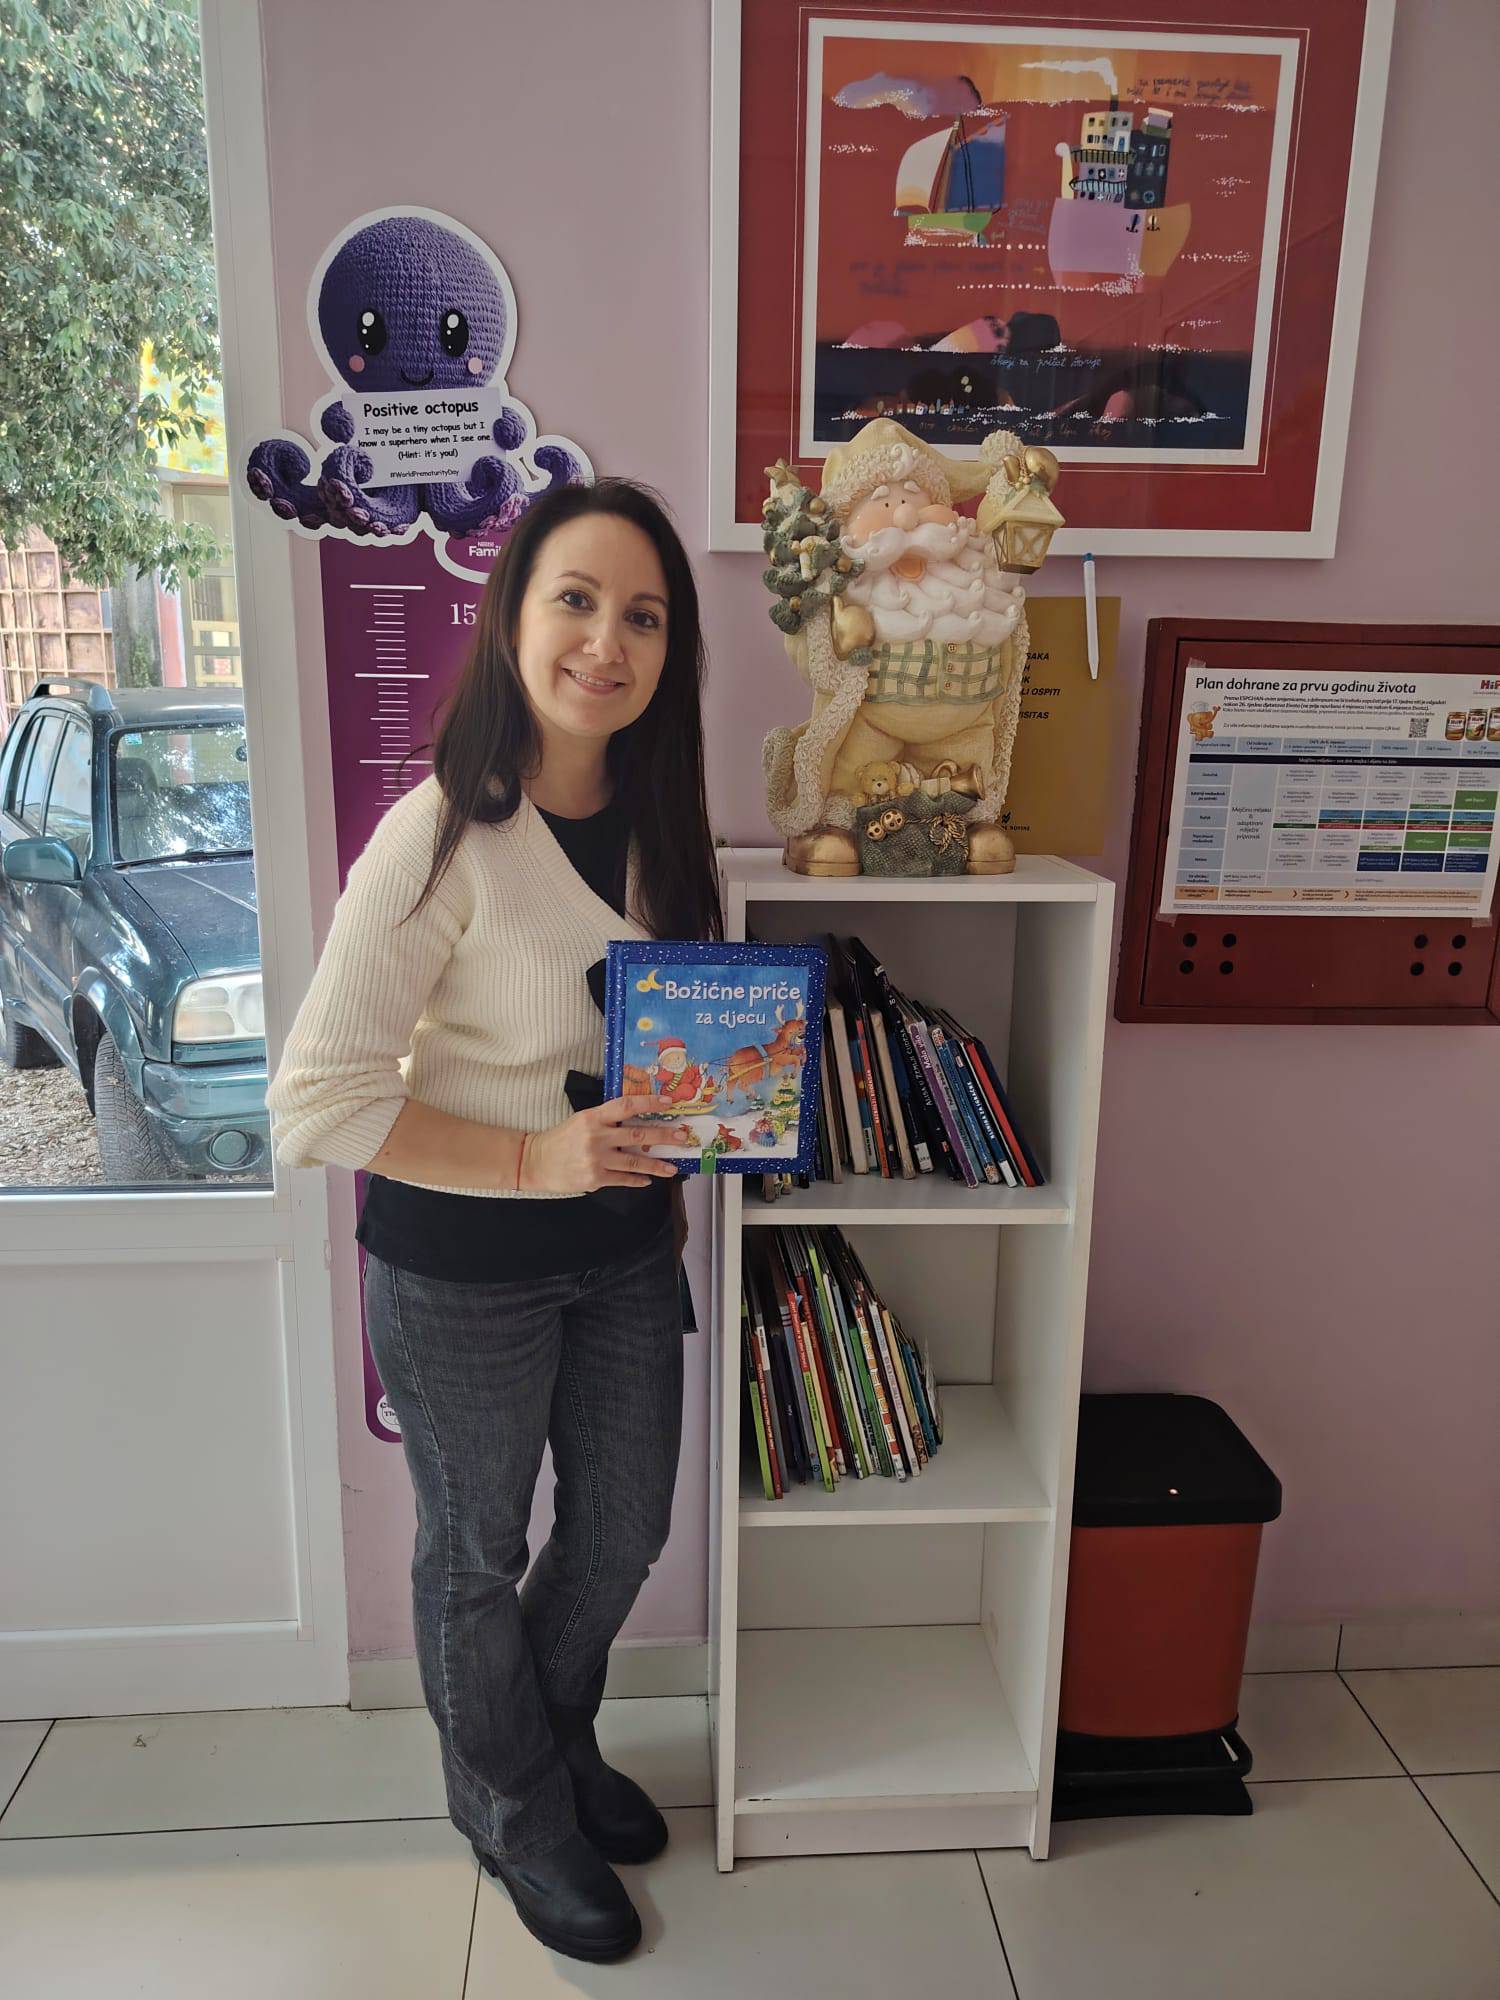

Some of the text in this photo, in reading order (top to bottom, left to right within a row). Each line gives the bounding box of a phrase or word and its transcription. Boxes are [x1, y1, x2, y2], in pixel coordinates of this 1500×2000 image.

[364, 401, 479, 417] Positive octopus
[373, 428, 389, 436] may
[413, 425, 428, 434] tiny
[431, 424, 460, 434] octopus
[358, 440, 378, 448] know
[389, 438, 428, 448] superhero
[398, 452, 421, 460] (Hint:
[425, 450, 437, 458] it's
[390, 470, 460, 478] #WorldPrematurityDay
[450, 603, 477, 625] 15
[1196, 677, 1417, 694] Plan dohrane za prvu godinu života
[1480, 680, 1500, 689] HiP
[1031, 688, 1061, 696] OSPITI
[665, 980, 800, 1007] Božićne priče
[695, 1010, 766, 1028] za djecu
[921, 1050, 932, 1069] Mala
